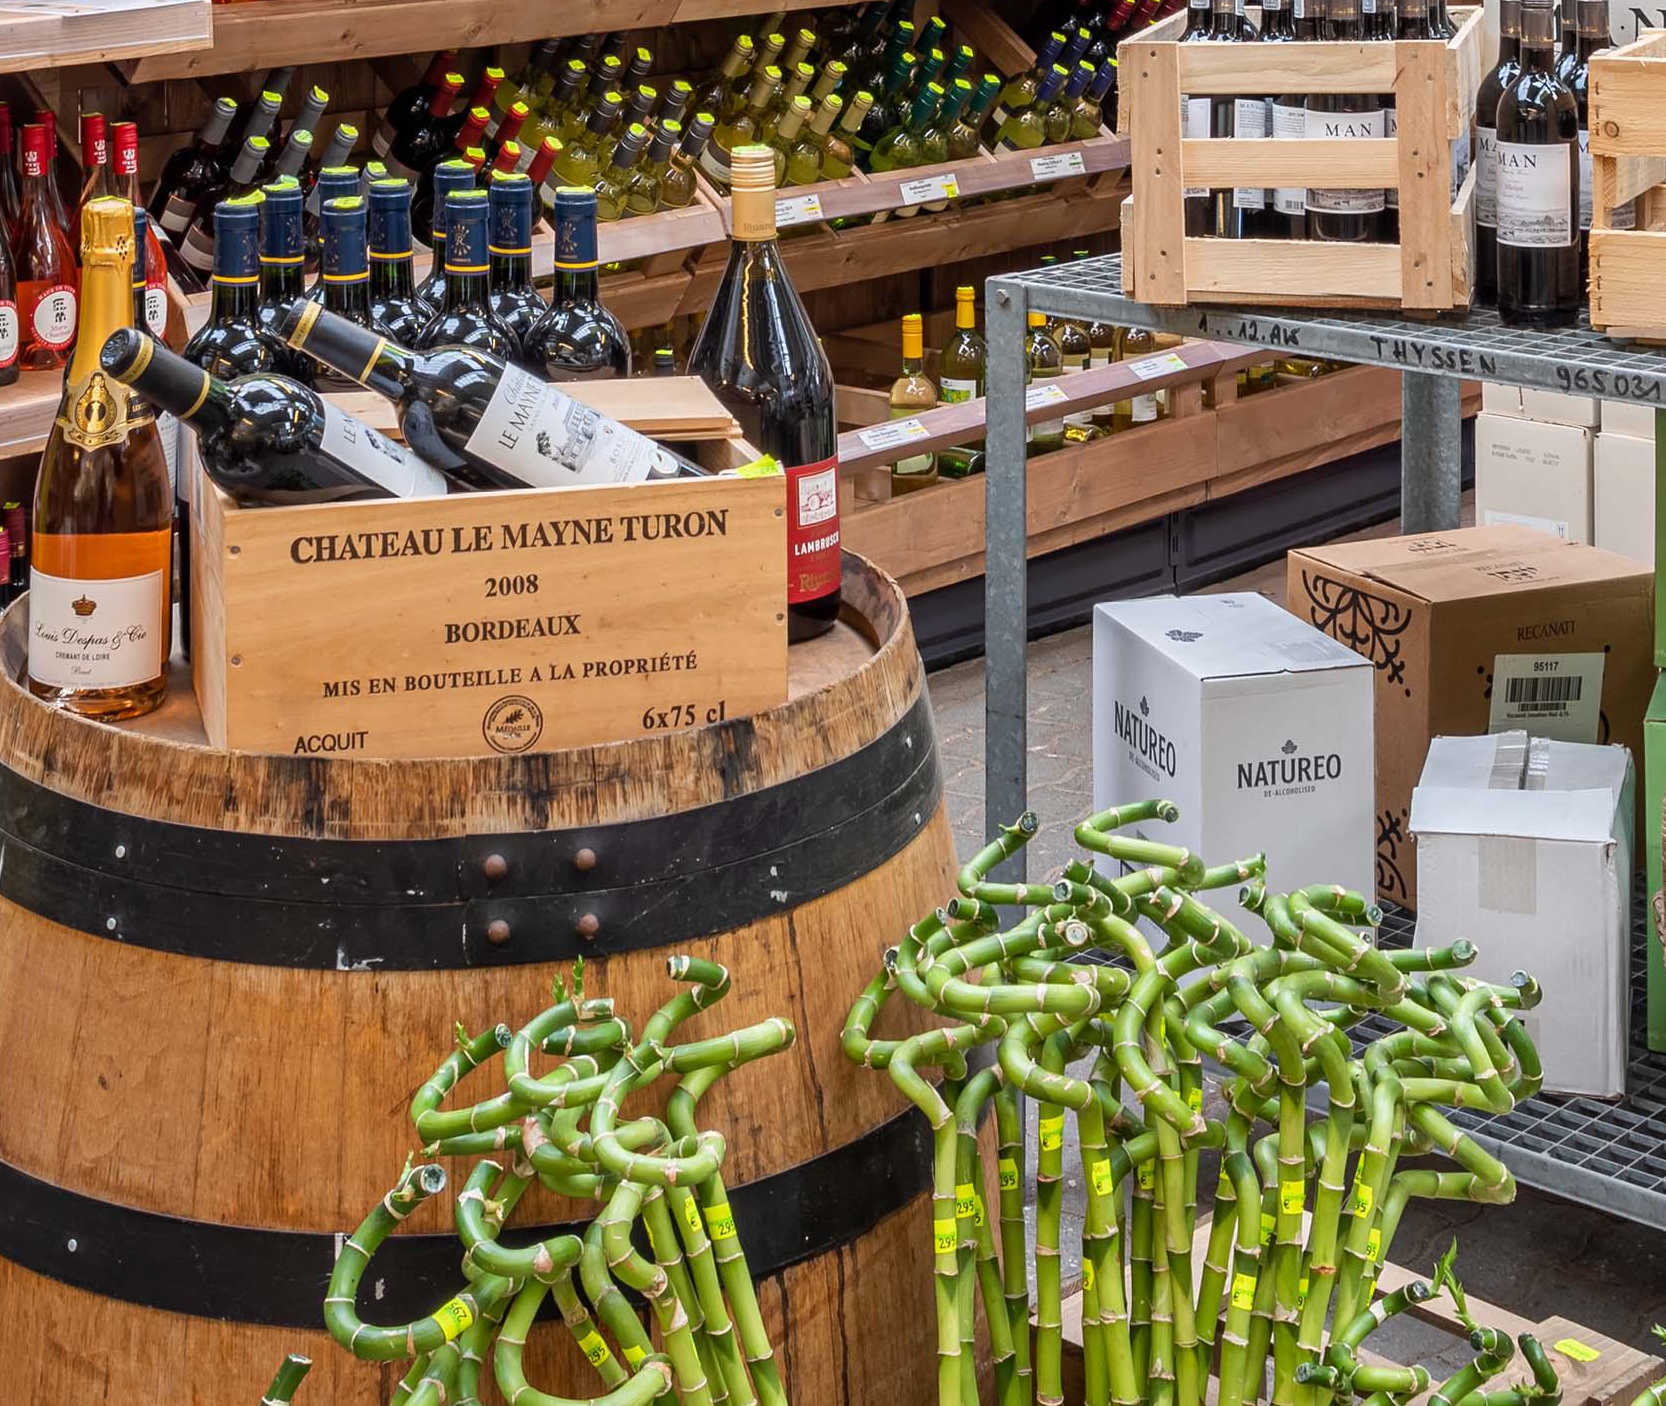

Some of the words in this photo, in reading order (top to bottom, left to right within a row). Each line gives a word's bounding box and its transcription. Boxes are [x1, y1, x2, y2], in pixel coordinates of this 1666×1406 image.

[1370, 335, 1497, 374] THYSSEN
[1556, 365, 1606, 392] 965
[498, 429, 520, 450] LE
[509, 382, 542, 432] MAYNE
[290, 527, 444, 567] CHATEAU
[452, 525, 492, 554] LE
[510, 517, 613, 550] MAYNE
[619, 508, 728, 542] TURON
[484, 574, 539, 598] 2008
[34, 621, 59, 642] Louis
[62, 627, 108, 651] Despas
[444, 614, 581, 645] BORDEAUX
[1517, 620, 1575, 641] RECANATI
[55, 651, 81, 660] CREMANT
[92, 653, 110, 661] LOIRE
[1533, 662, 1559, 672] 95117
[323, 679, 362, 699] MIS
[368, 677, 398, 696] EN
[404, 669, 524, 695] BOUTEILLE
[529, 667, 545, 686] A
[550, 664, 577, 684] LA
[582, 651, 698, 681] PROPRIÉTÉ
[642, 704, 694, 731] 6x75
[705, 700, 727, 725] cl
[293, 731, 369, 755] ACQUIT
[1113, 699, 1177, 779] NATUREO
[1236, 752, 1342, 790] NATUREO
[1264, 784, 1317, 799] DE-ALCOHOLISED
